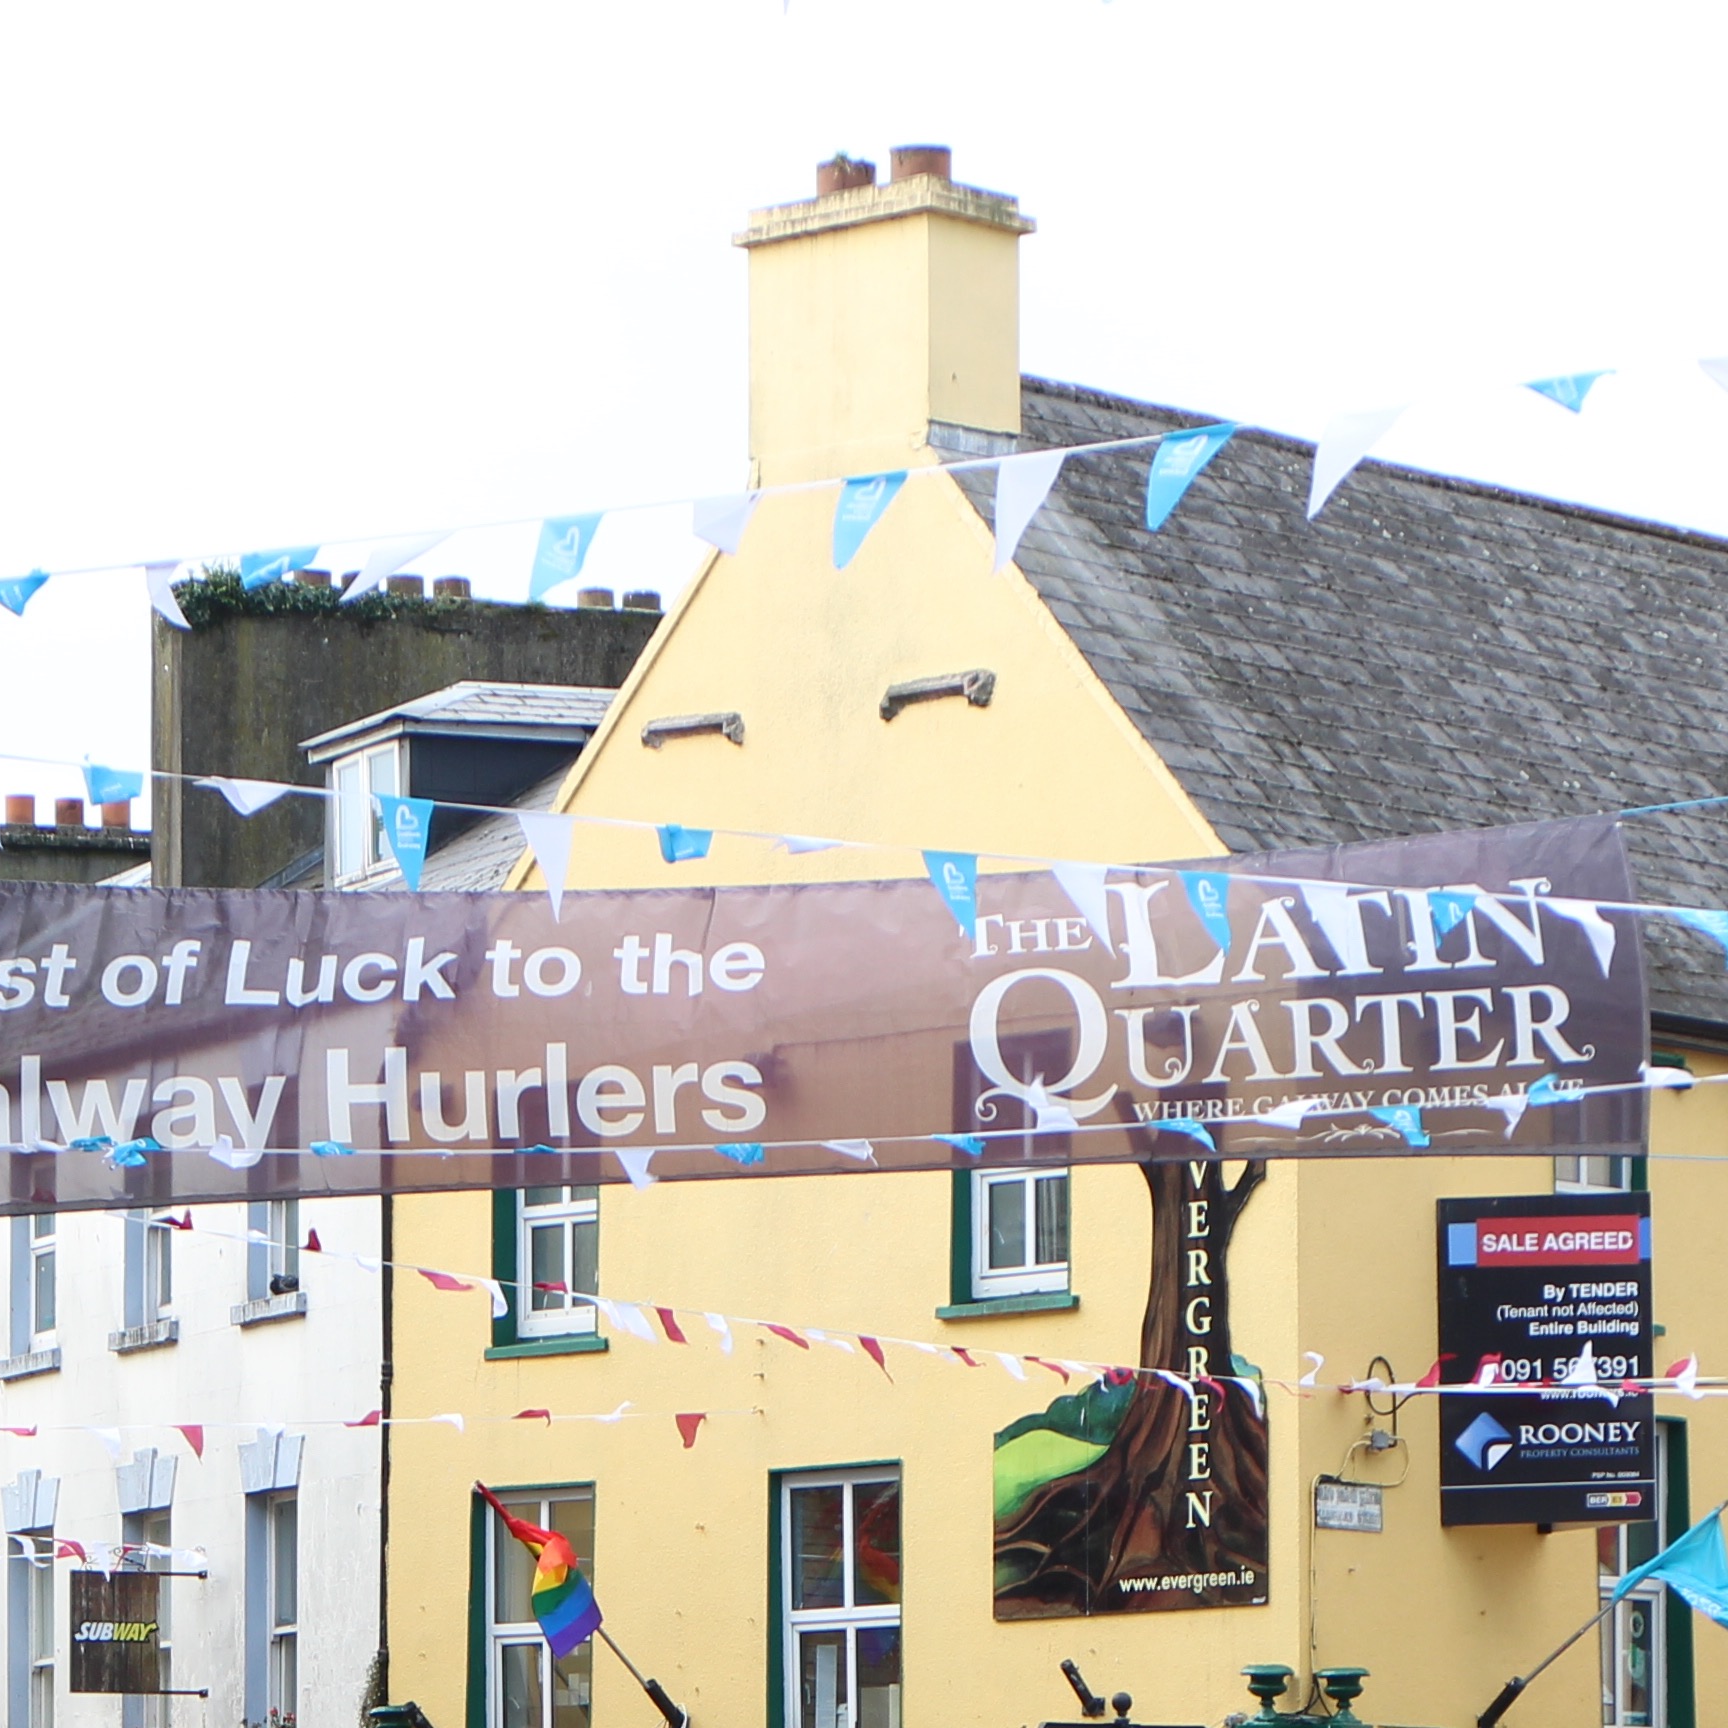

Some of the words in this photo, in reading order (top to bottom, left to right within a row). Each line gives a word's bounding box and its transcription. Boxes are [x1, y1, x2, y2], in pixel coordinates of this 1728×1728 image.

[960, 912, 1092, 960] THE
[1101, 875, 1553, 990] LATIN
[101, 939, 201, 1009] of
[225, 936, 459, 1008] Luck
[485, 938, 582, 998] to
[613, 932, 765, 997] the
[969, 966, 1596, 1123] QUARTER
[326, 1042, 767, 1147] Hurlers
[1133, 1097, 1247, 1122] WHERE
[1381, 1084, 1488, 1109] COMES
[1499, 1078, 1584, 1102] ALVE
[1482, 1233, 1539, 1253] SALE
[1543, 1231, 1633, 1251] AGREED
[1544, 1284, 1565, 1303] By
[1569, 1281, 1639, 1299] TENDER
[1497, 1304, 1548, 1321] (Tenant
[1552, 1304, 1574, 1317] not
[1577, 1301, 1639, 1318] Affected)
[1529, 1322, 1574, 1336] Entire
[1577, 1320, 1639, 1336] Building
[1501, 1359, 1542, 1381] 091
[1519, 1421, 1641, 1446] ROONEY
[1521, 1449, 1569, 1459] PROPERTY
[1570, 1446, 1639, 1457] CONSULTANTS
[1119, 1566, 1256, 1594] www.evergreen.ie
[75, 1620, 159, 1643] SUBWAY
